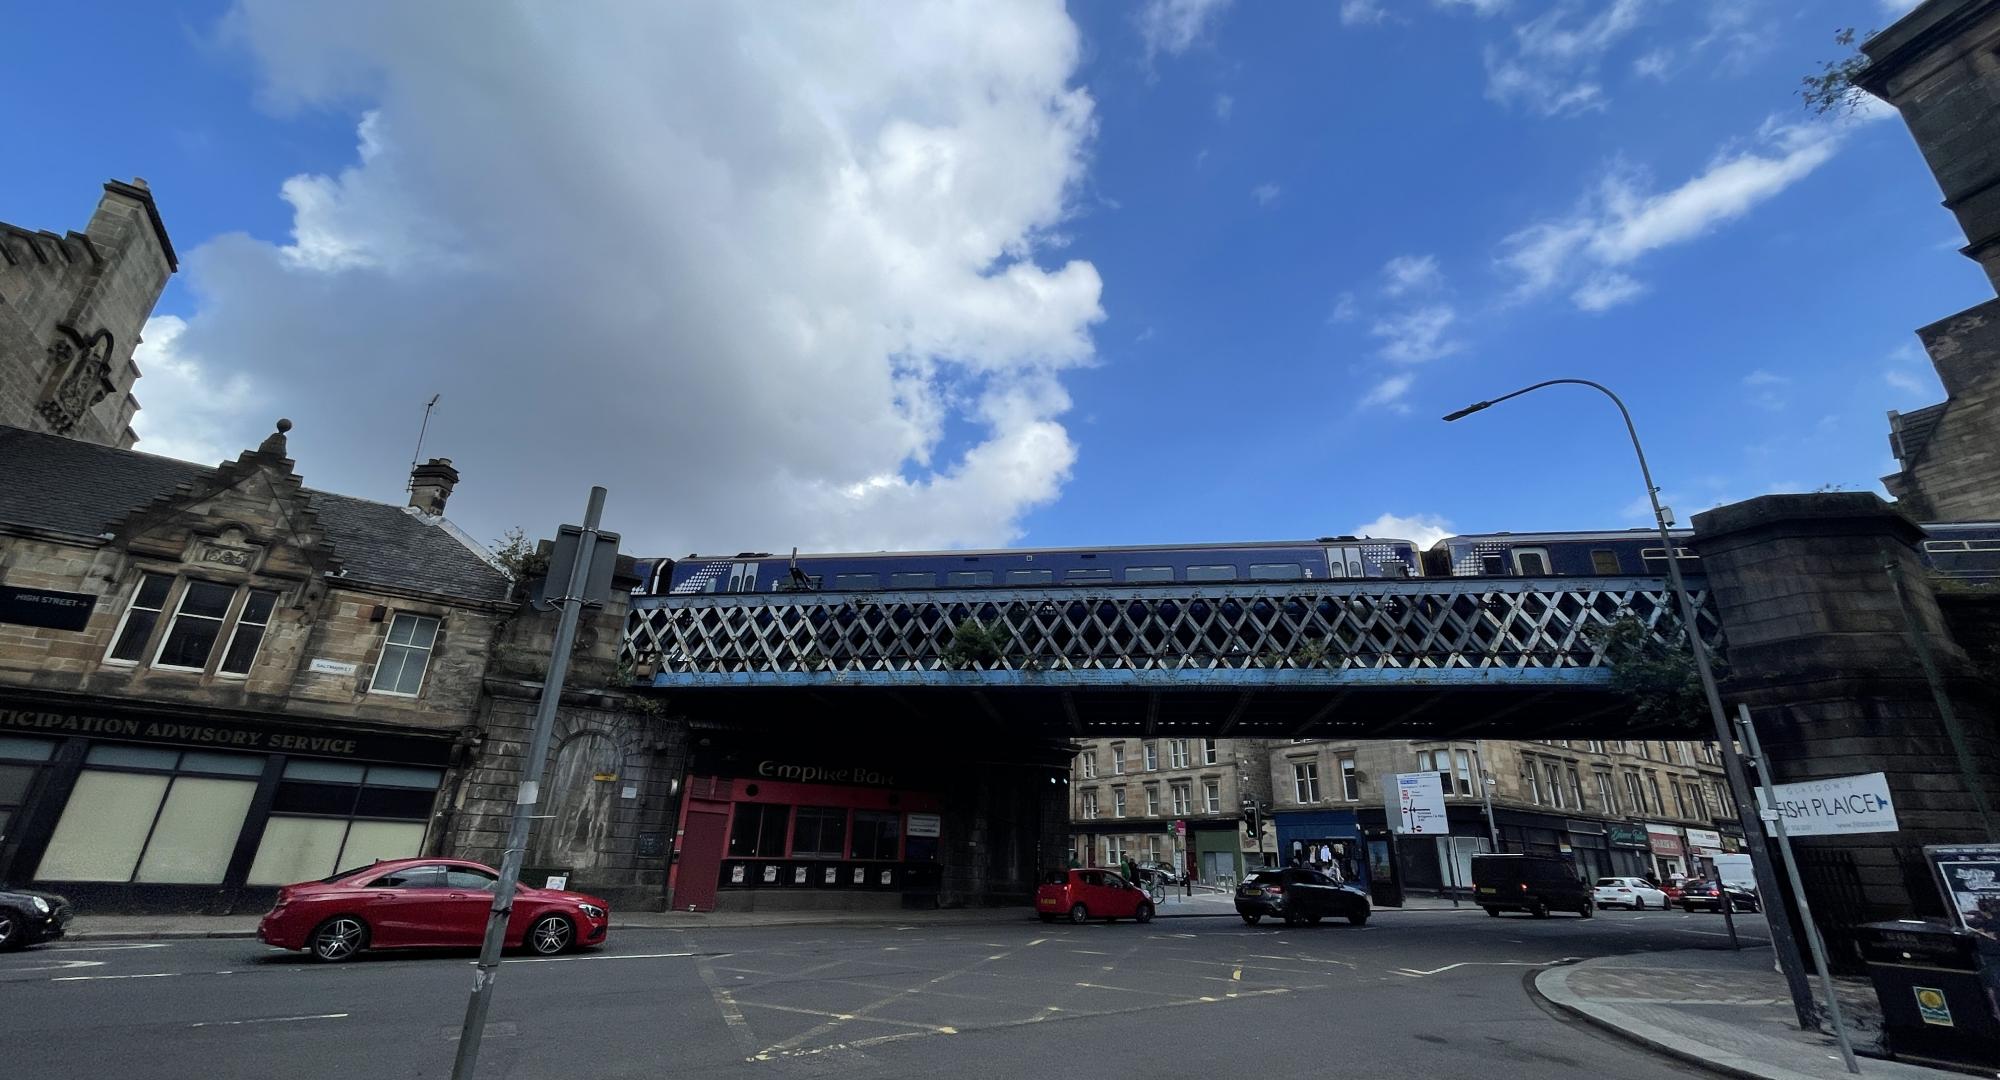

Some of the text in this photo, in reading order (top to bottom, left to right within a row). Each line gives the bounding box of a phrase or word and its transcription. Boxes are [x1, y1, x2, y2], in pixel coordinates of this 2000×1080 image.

[41, 596, 79, 607] STREET
[145, 722, 263, 746] ADVISORY
[268, 734, 358, 753] SERVICE
[758, 760, 848, 783] Empire
[1811, 793, 1877, 816] PLAICE
